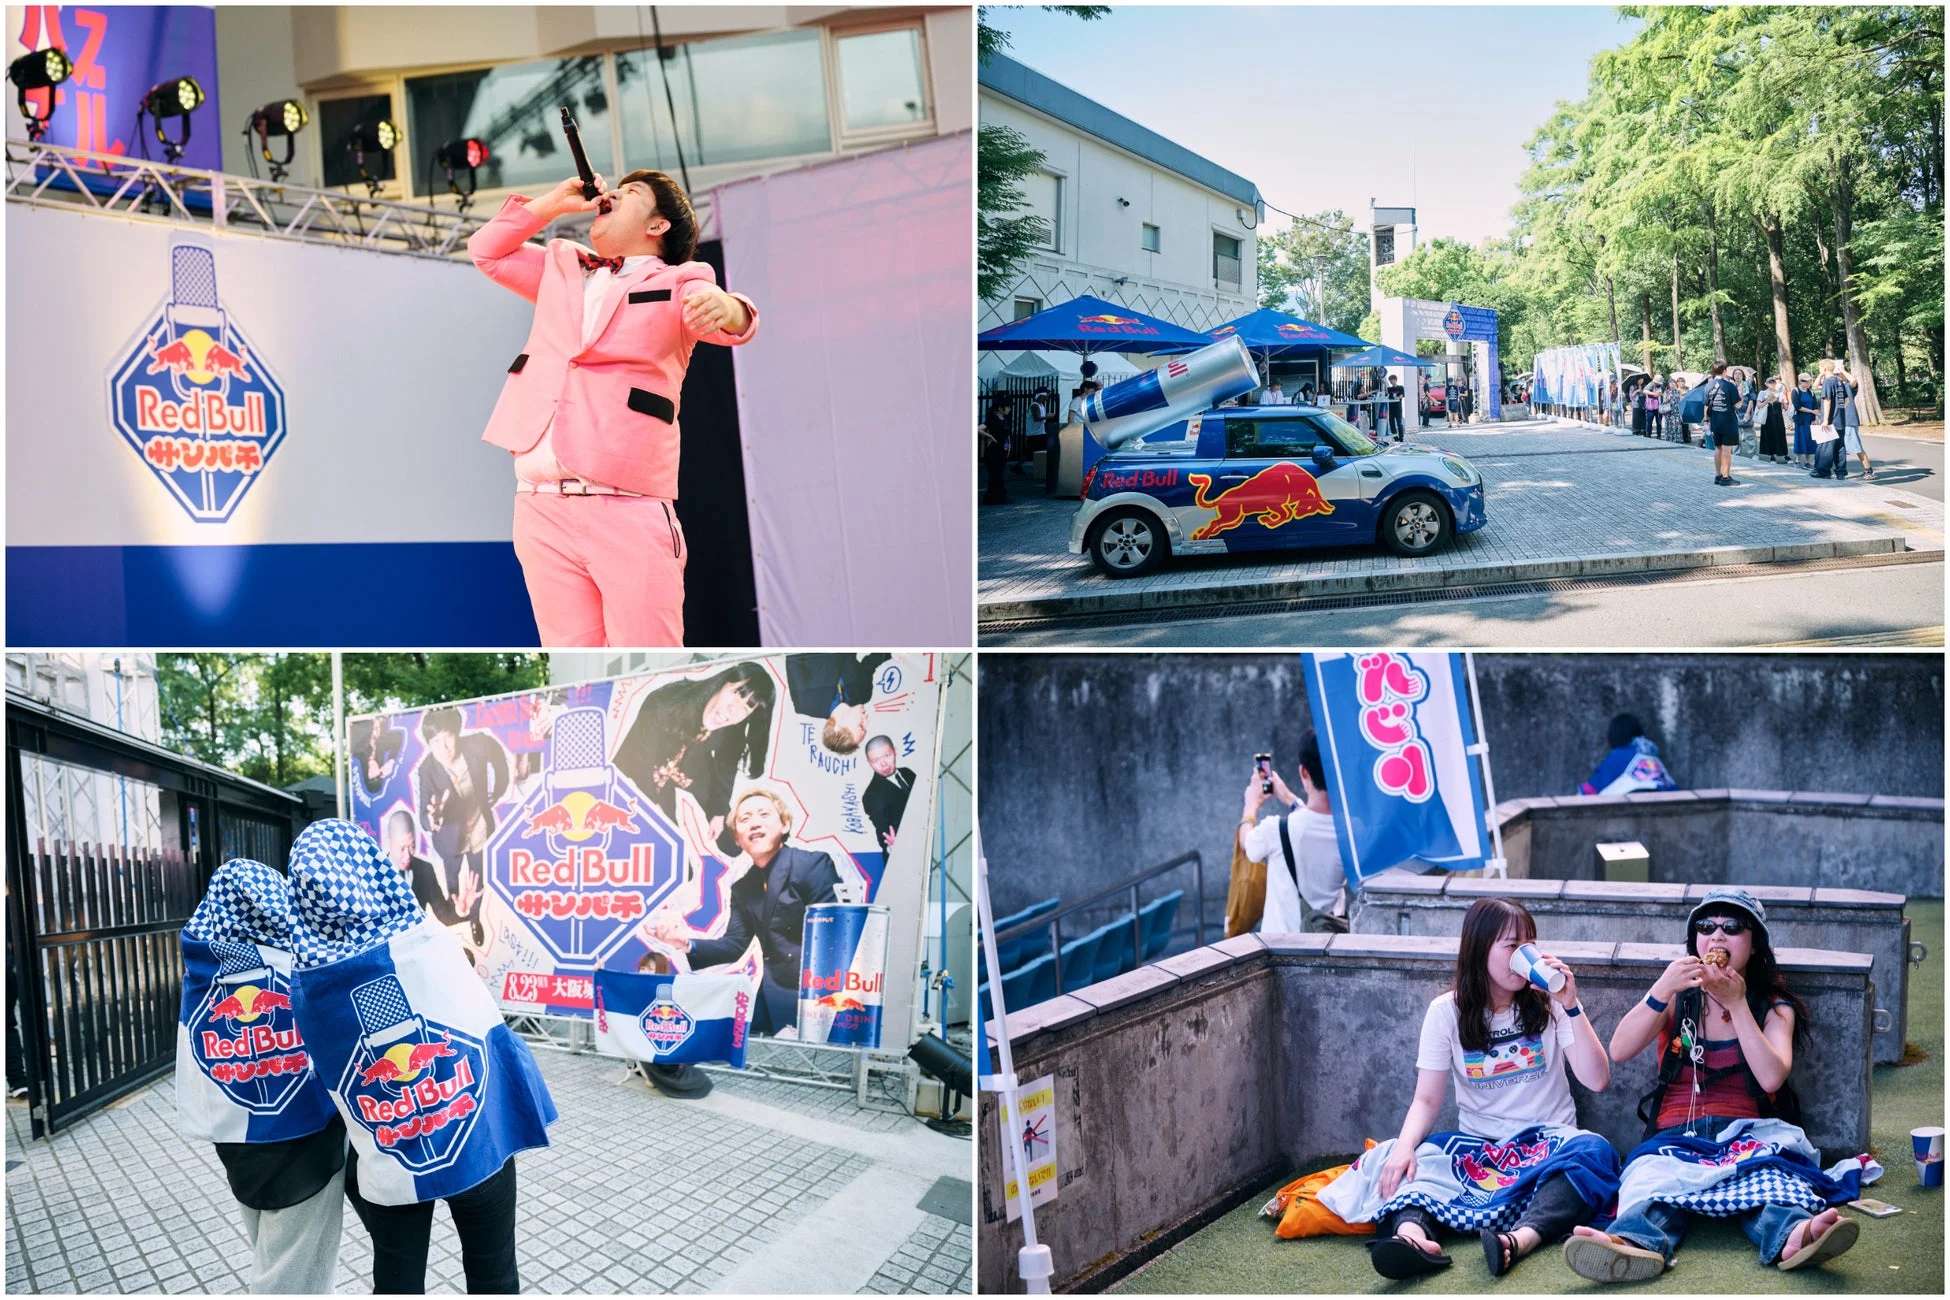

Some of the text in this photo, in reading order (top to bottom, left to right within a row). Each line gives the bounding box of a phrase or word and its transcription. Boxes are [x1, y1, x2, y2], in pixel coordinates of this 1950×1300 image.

[138, 387, 264, 433] Red Bull
[1102, 467, 1178, 489] Red Bull
[512, 846, 652, 884] Red Bull
[517, 893, 643, 918] サンパチ
[508, 973, 538, 1002] 8.23
[802, 968, 883, 993] Red Bull
[203, 1020, 303, 1058] Red Bul
[646, 1019, 687, 1032] Red Bull
[357, 1057, 474, 1121] Red Bull
